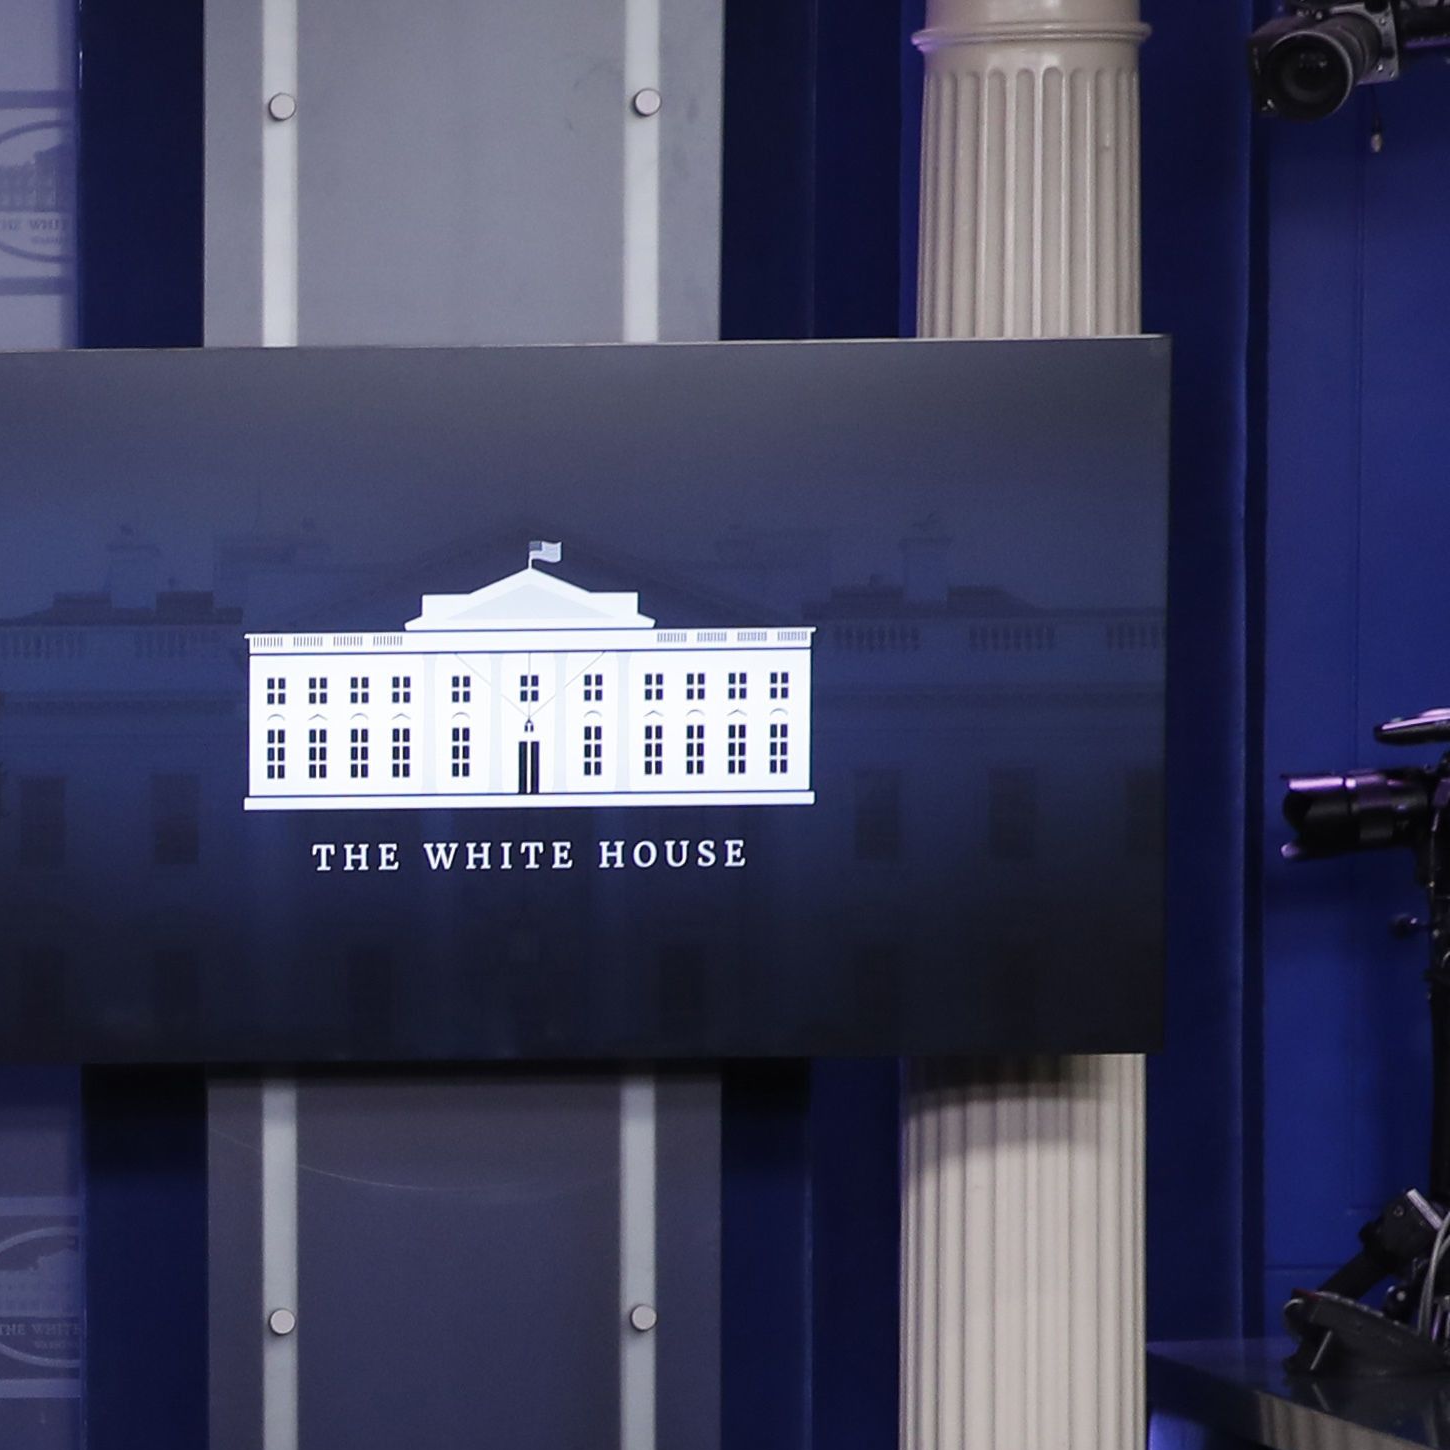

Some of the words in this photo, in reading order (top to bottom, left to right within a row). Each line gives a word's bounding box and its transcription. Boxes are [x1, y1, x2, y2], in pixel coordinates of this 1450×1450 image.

[312, 843, 399, 871] THE
[423, 841, 573, 870] WHITE
[598, 839, 746, 869] HOUSE
